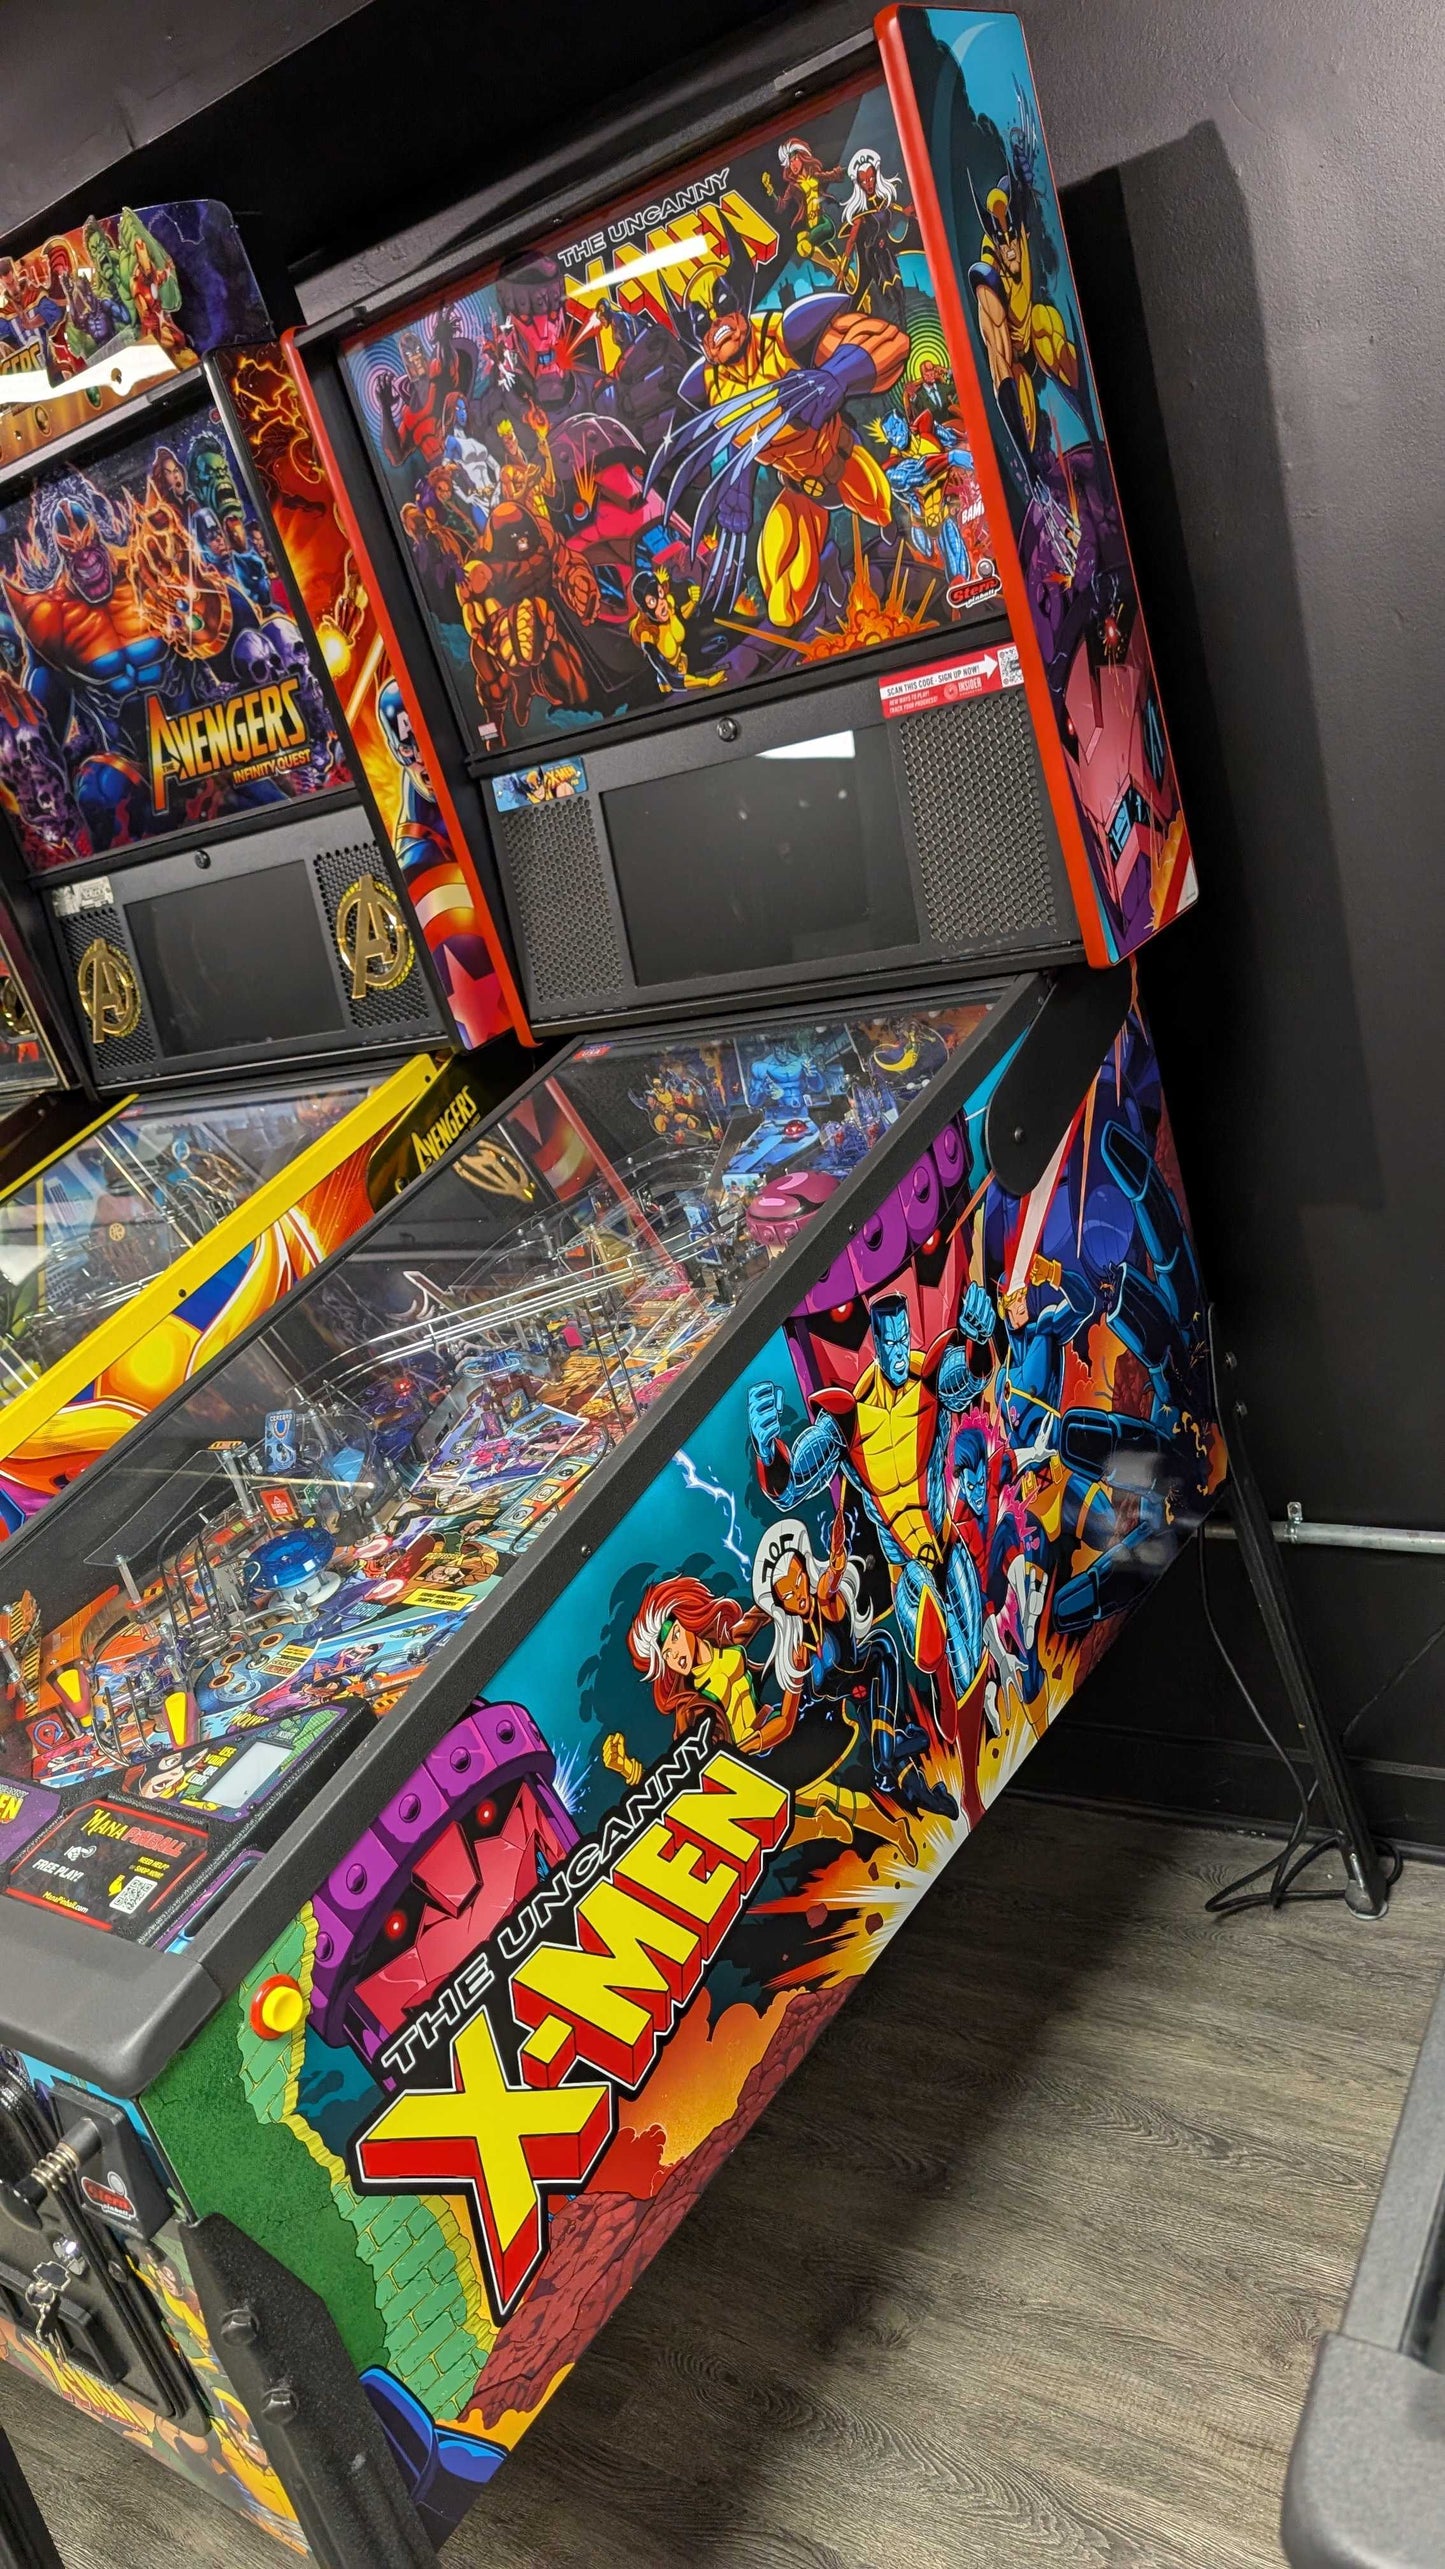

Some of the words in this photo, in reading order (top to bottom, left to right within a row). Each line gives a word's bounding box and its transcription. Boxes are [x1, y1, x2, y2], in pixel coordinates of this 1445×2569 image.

[558, 233, 607, 268] THE
[608, 167, 730, 243] UNCANNY
[952, 579, 996, 602] Stern
[968, 589, 994, 605] pinball
[886, 686, 903, 697] SCAN
[903, 683, 918, 693] THIS
[918, 678, 934, 689] CODE
[938, 673, 953, 683] SIGN
[953, 670, 961, 679] UP
[963, 664, 981, 676] NOW!
[957, 677, 982, 692] INSIDER
[147, 678, 306, 812] AVENGERS
[161, 763, 175, 773] THE
[233, 760, 276, 784] INFINITY
[276, 749, 311, 771] QUEST
[411, 1085, 478, 1174] AVENGERS
[81, 1808, 129, 1841] MANA
[121, 1826, 187, 1859] PINBALL
[32, 1858, 57, 1875] FREE
[54, 1864, 85, 1883] PLAY!
[42, 1890, 90, 1915] ManaPinball.com
[381, 1951, 496, 2075] THE
[498, 1717, 713, 1958] UNCANNY
[357, 1749, 790, 2316] X-MEN
[84, 2180, 133, 2211] Stern
